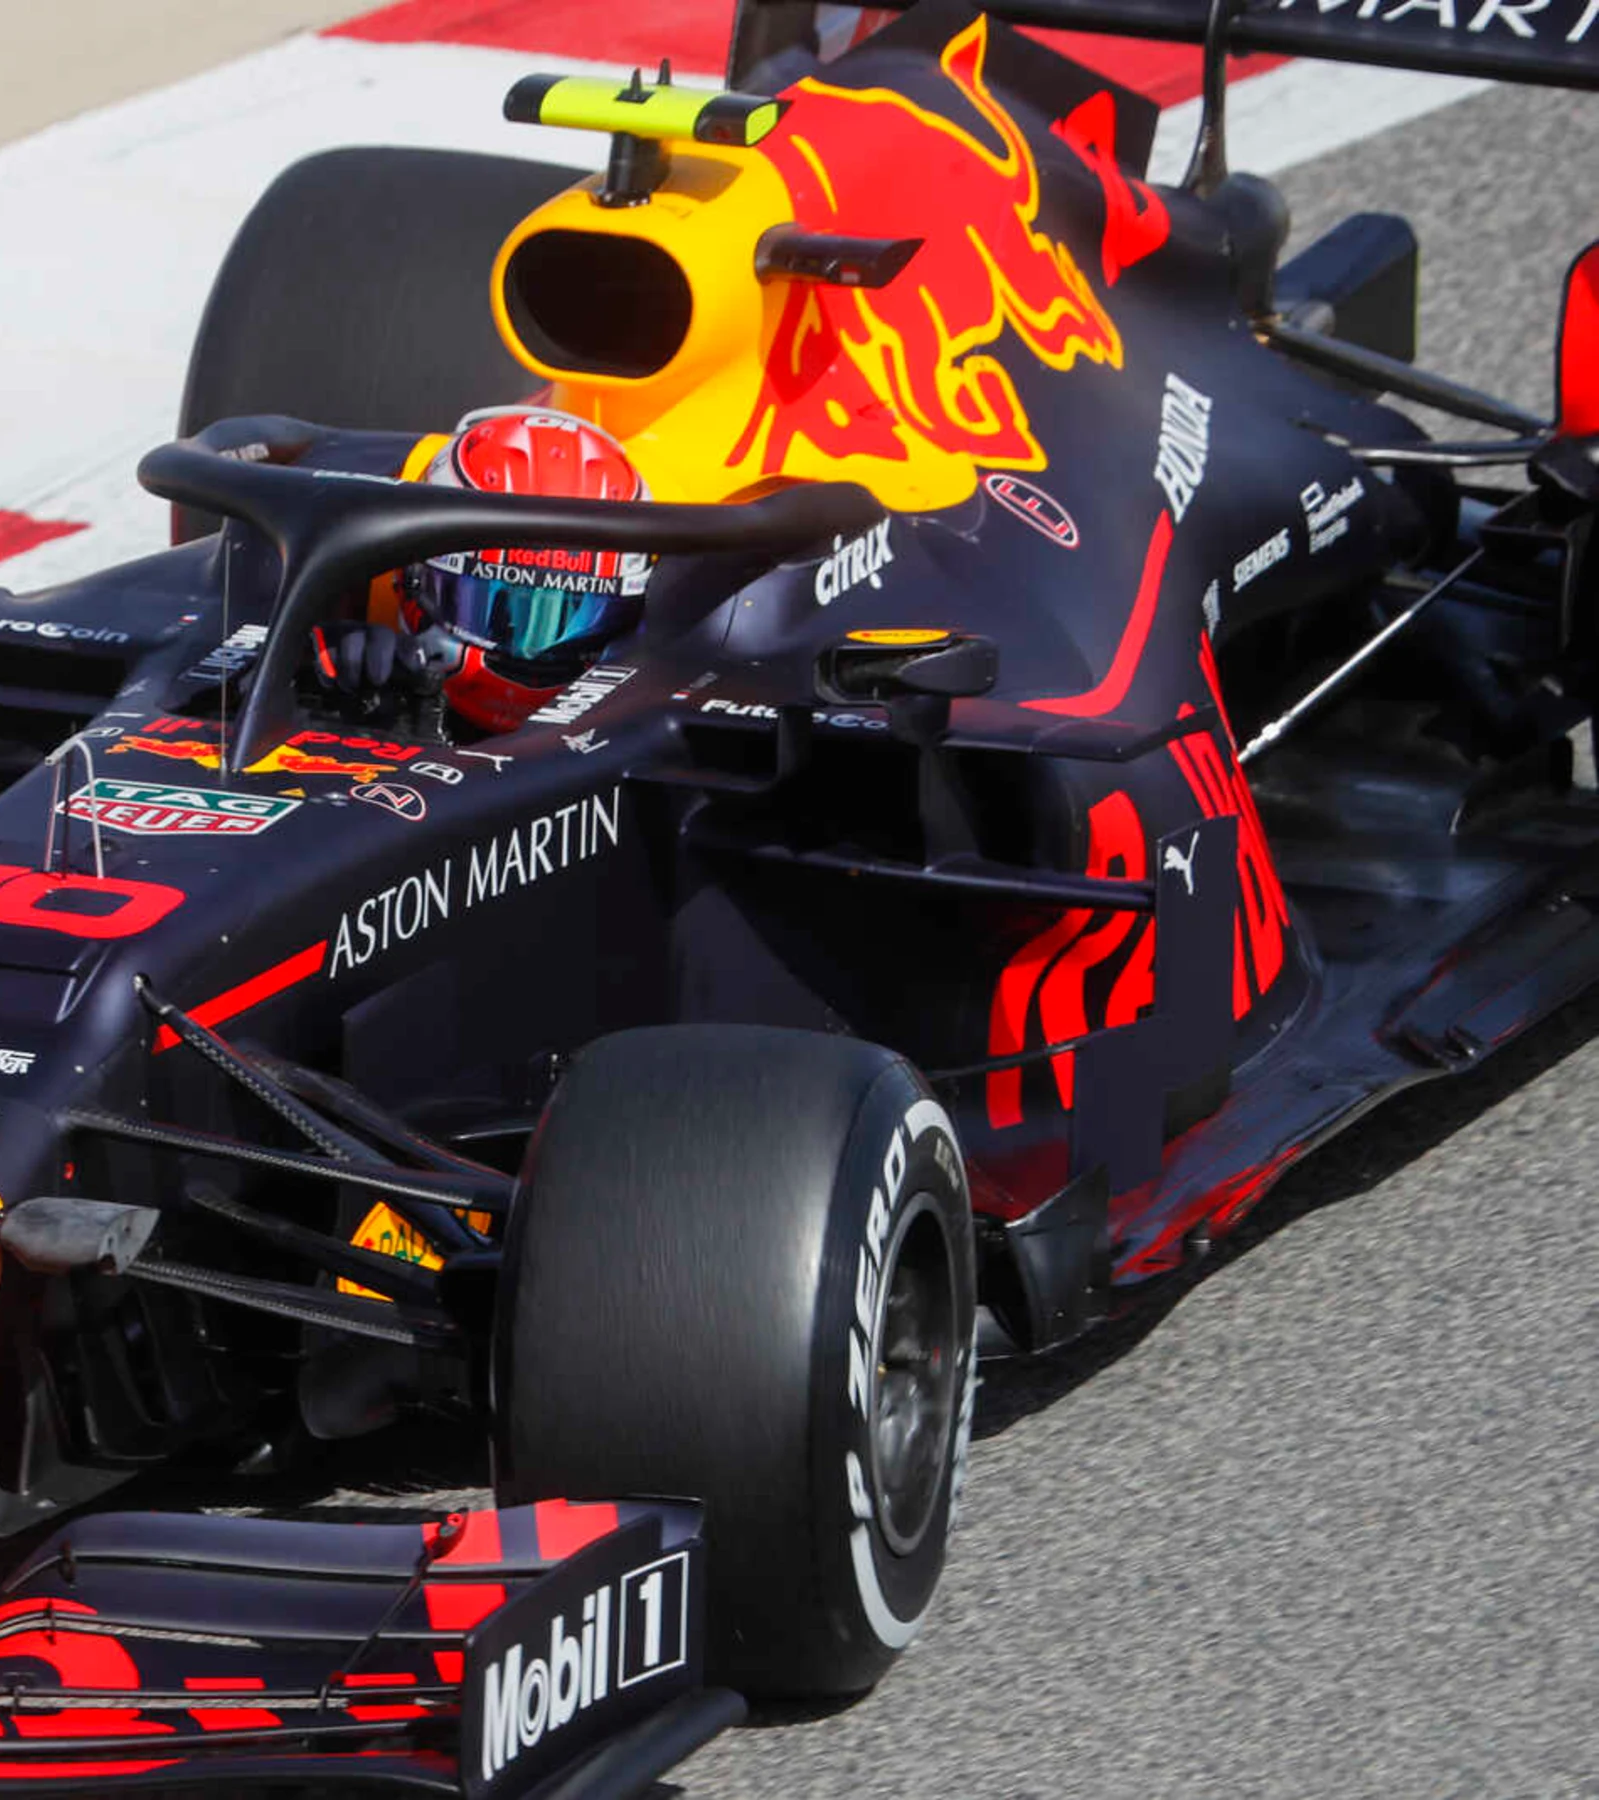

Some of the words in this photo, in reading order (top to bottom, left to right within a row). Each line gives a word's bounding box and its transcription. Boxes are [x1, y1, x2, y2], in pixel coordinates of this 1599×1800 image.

[1154, 372, 1213, 524] HONDA
[471, 562, 536, 586] ASTON
[543, 573, 617, 593] MARTIN
[552, 549, 591, 573] Bull
[528, 681, 617, 724] Mobil
[70, 801, 256, 830] HEUER
[106, 784, 276, 814] TAG
[329, 858, 451, 979] ASTON
[466, 786, 620, 907] MARTIN
[848, 1126, 906, 1423] ZERO
[846, 1450, 872, 1519] P
[482, 1585, 611, 1781] Mobil
